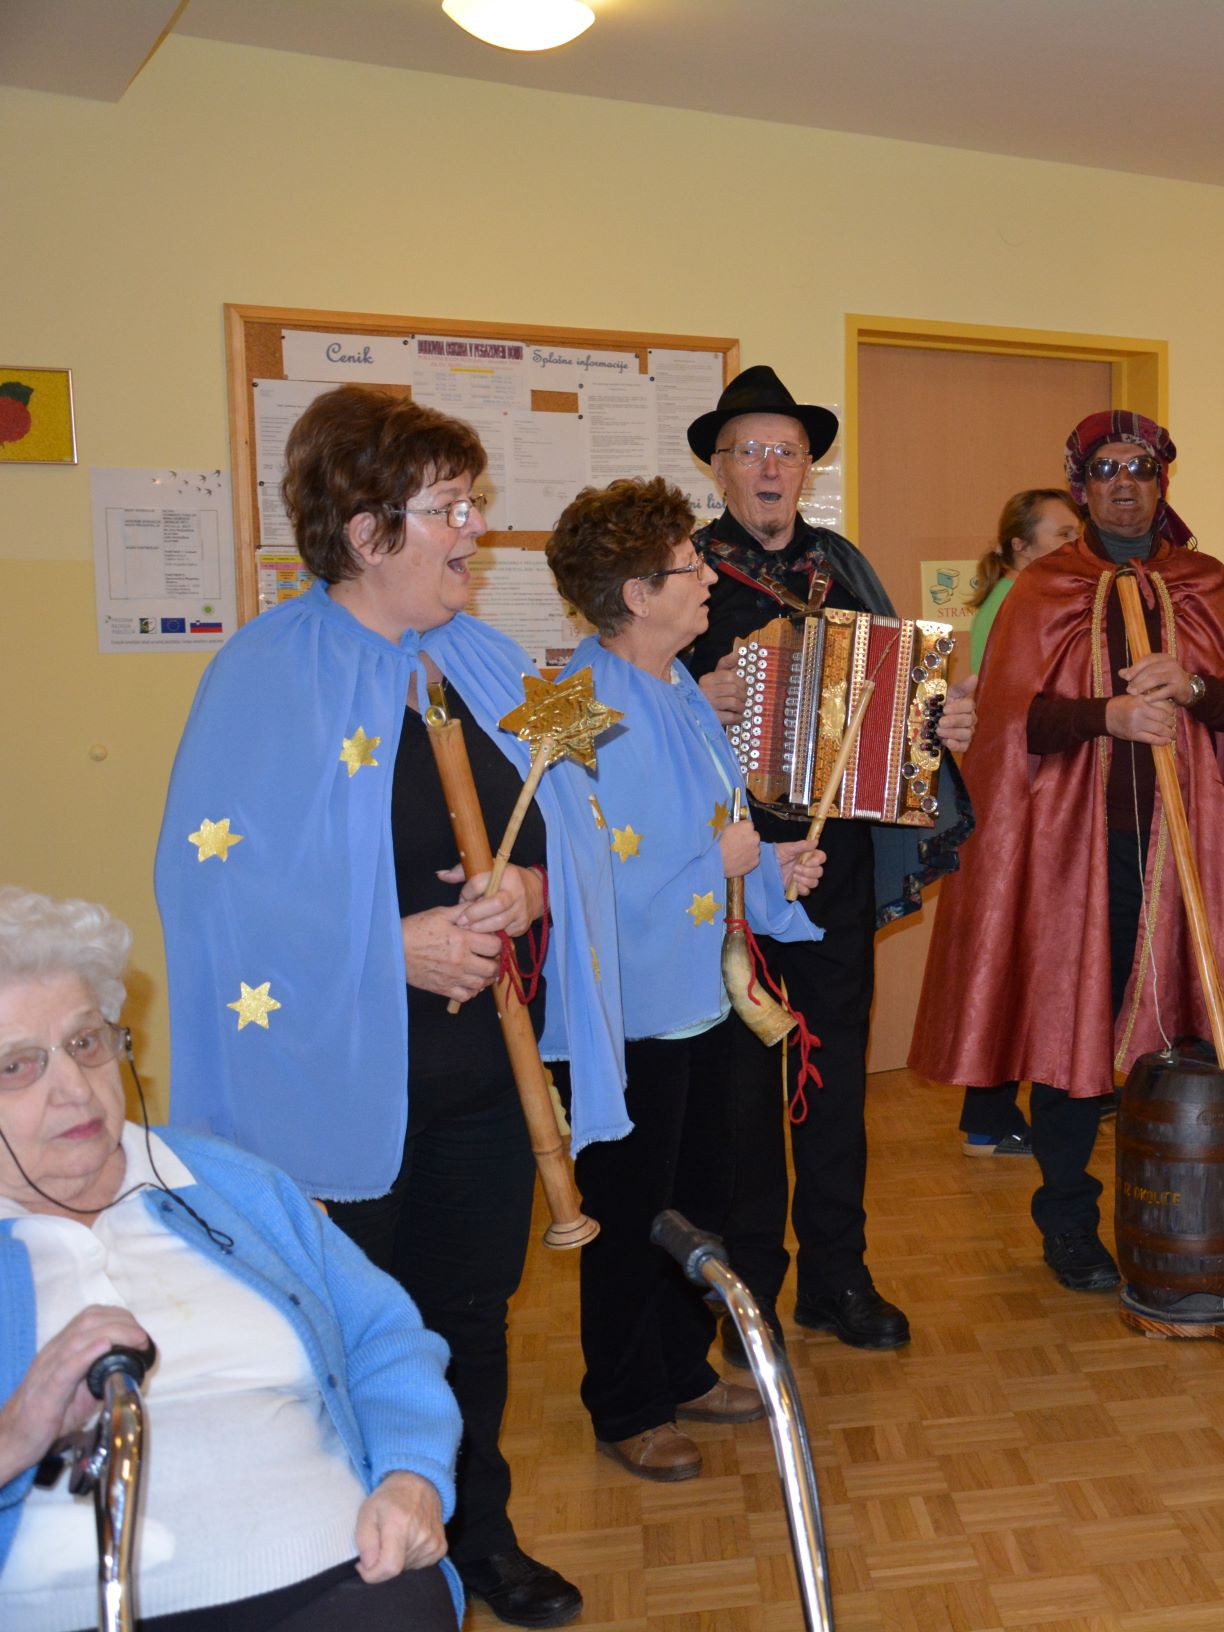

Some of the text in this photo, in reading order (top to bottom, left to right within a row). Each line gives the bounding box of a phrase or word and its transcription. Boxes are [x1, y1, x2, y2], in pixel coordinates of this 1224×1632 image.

[326, 342, 374, 364] Cenik
[532, 349, 573, 368] Splošne
[576, 354, 628, 374] informacije
[937, 607, 977, 618] STRAN
